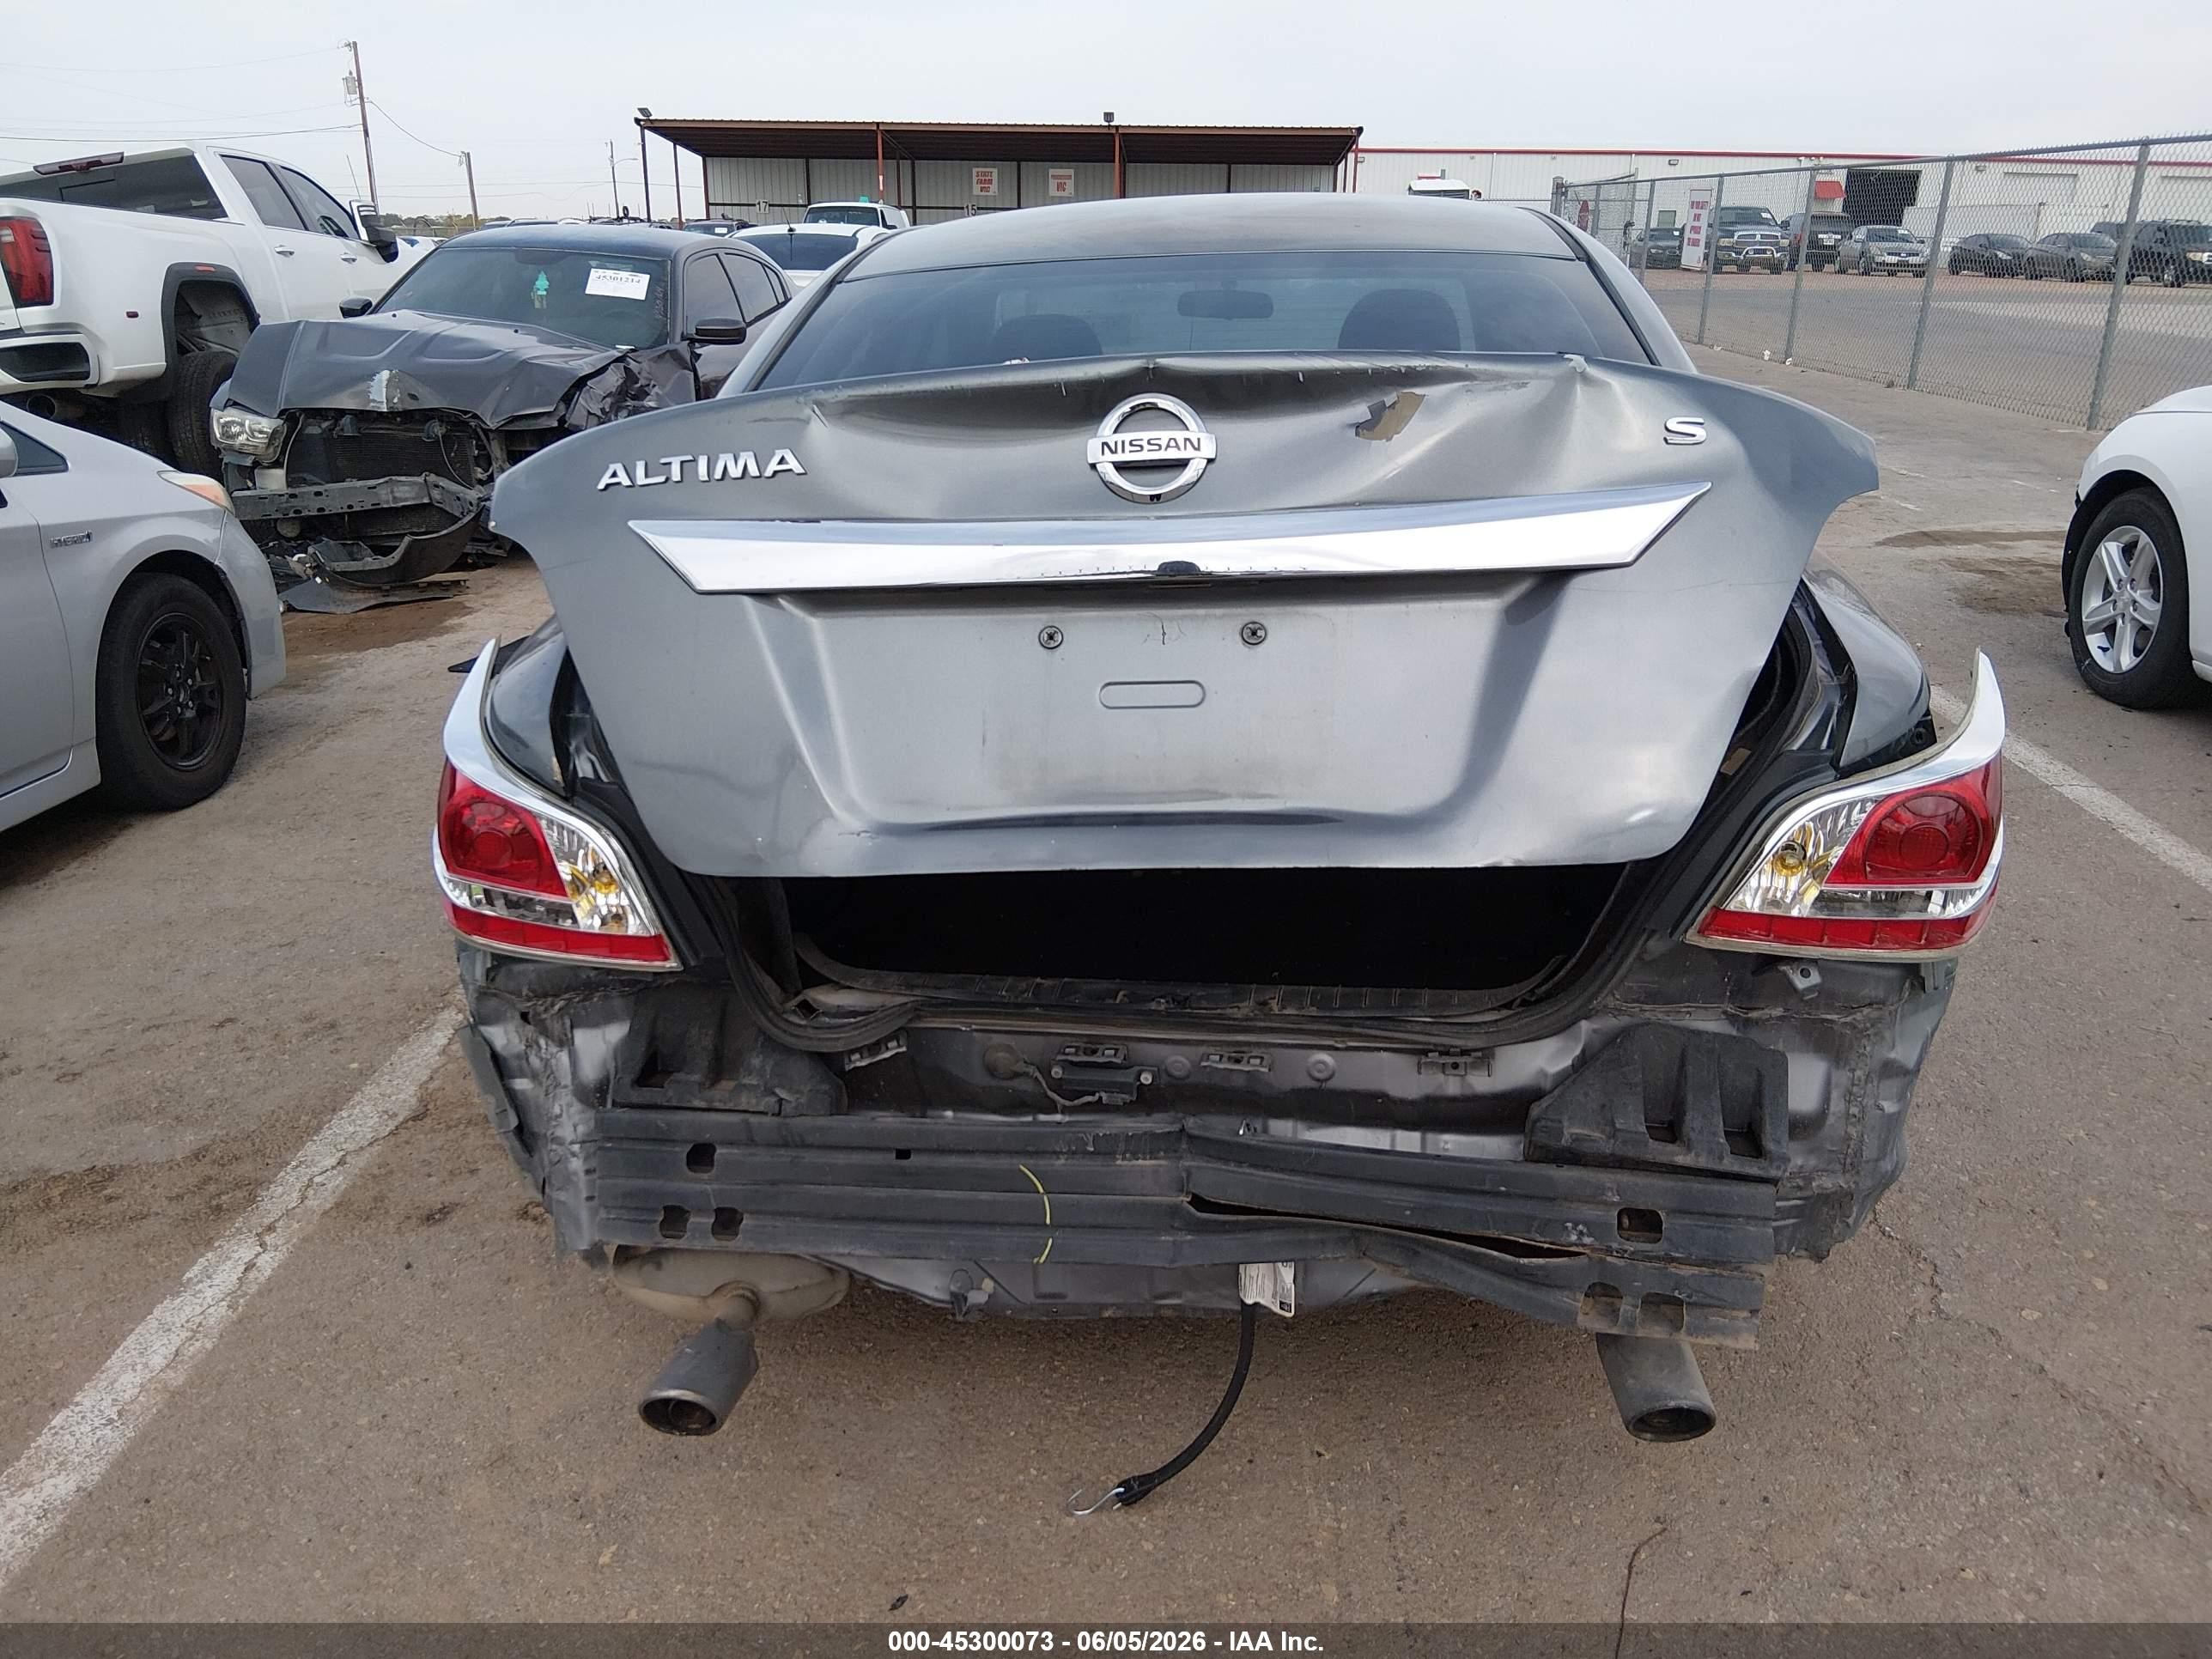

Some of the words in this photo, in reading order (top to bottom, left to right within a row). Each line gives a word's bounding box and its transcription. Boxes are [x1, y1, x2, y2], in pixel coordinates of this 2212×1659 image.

[757, 200, 769, 212] 17
[965, 204, 977, 216] 15
[1663, 416, 1707, 446] S
[1101, 437, 1201, 456] NISSAN
[596, 448, 808, 491] ALTIMA
